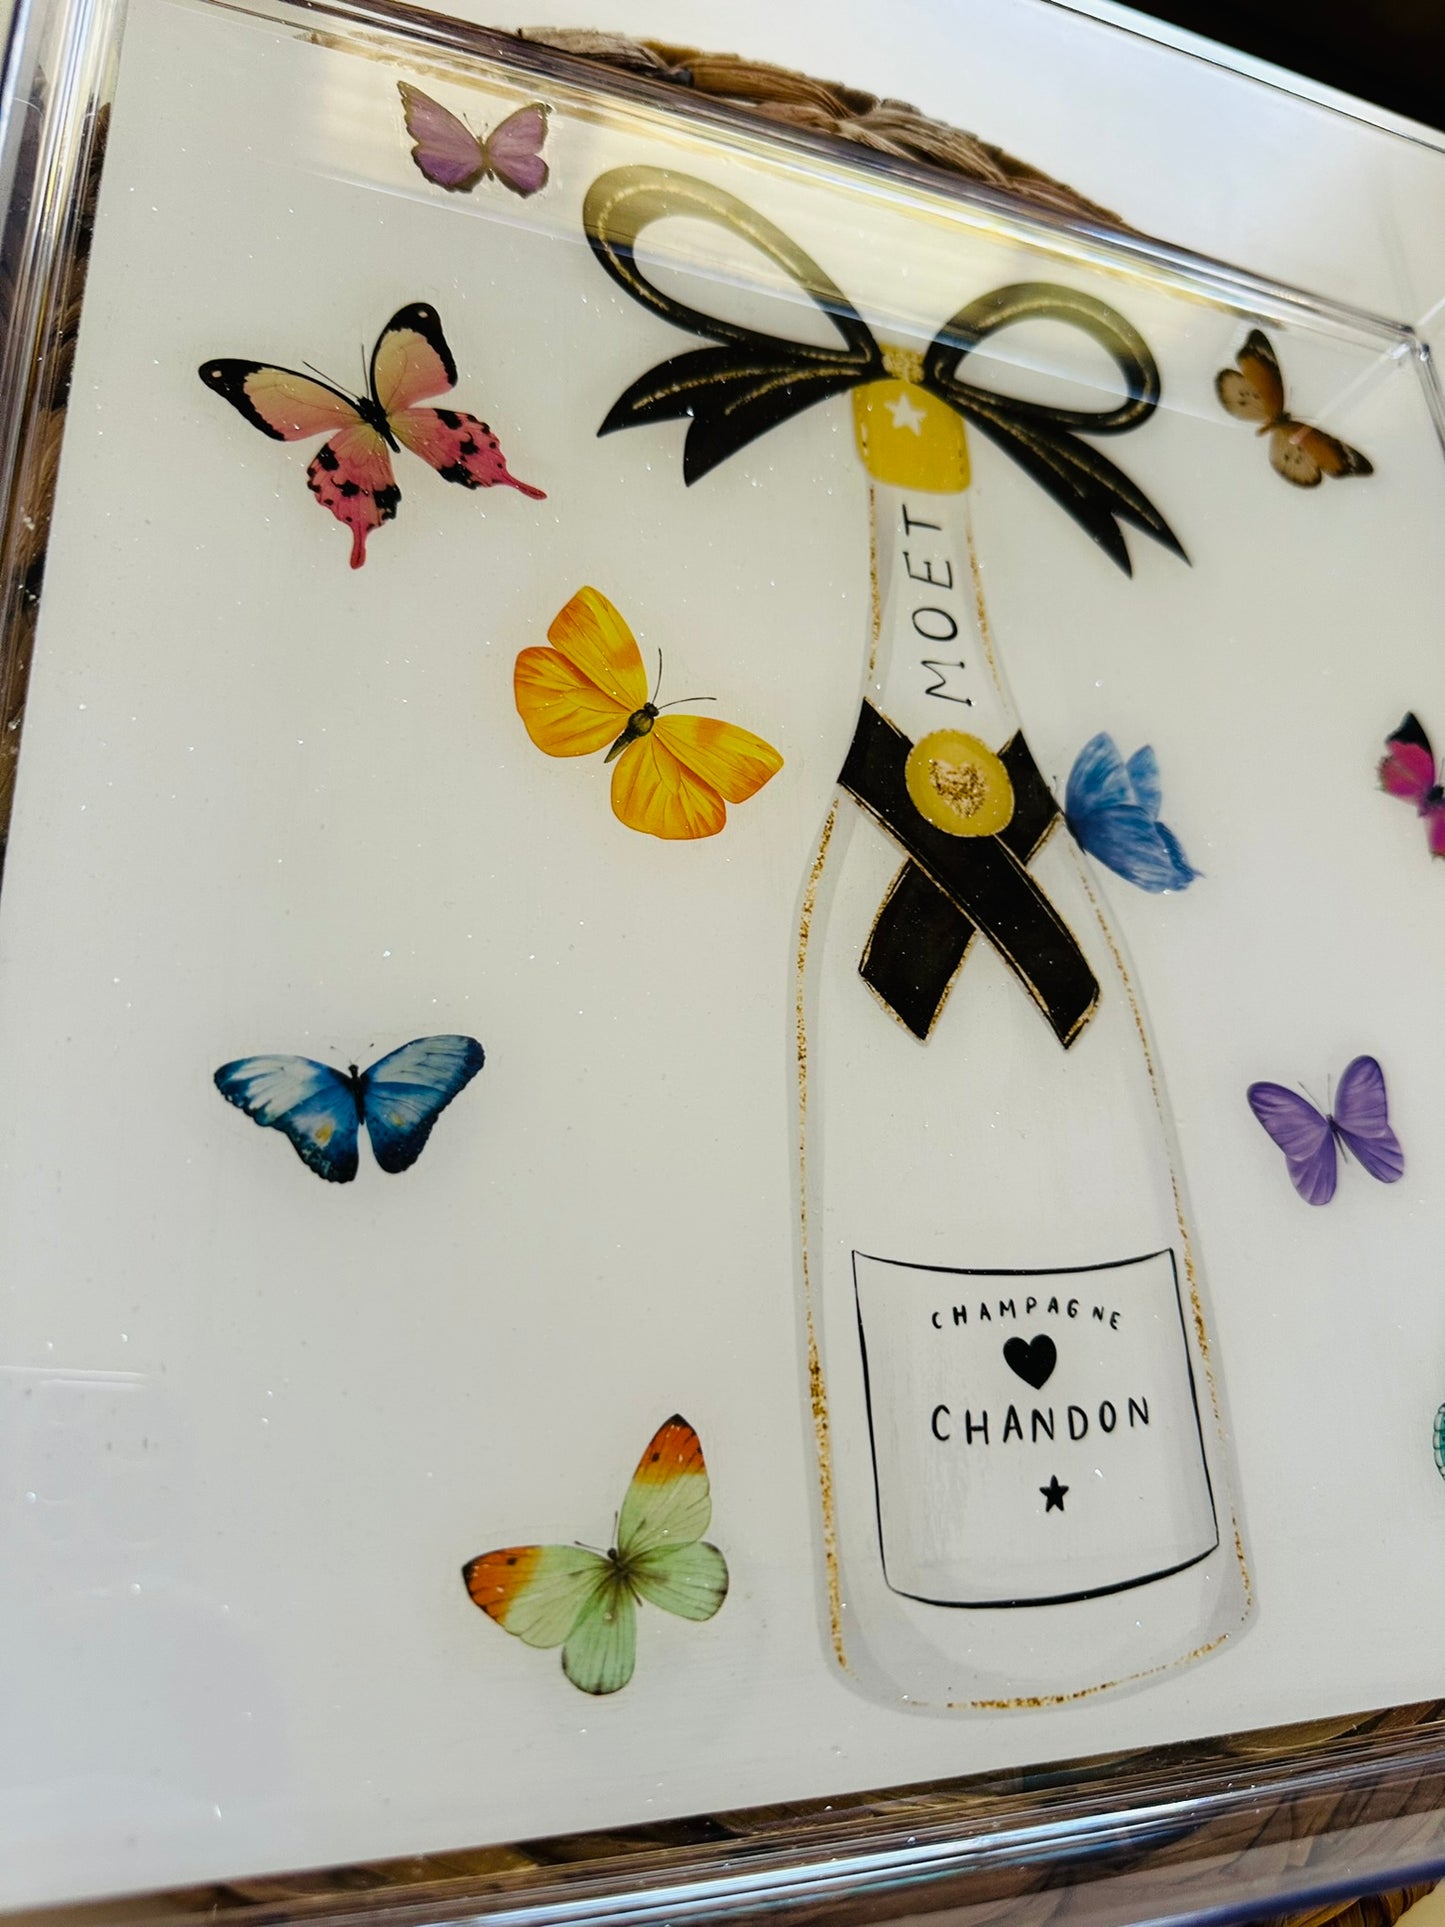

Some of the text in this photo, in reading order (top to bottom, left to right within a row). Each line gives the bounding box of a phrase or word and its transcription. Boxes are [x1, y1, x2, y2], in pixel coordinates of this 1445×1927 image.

[901, 503, 973, 708] MOET
[930, 1295, 1123, 1331] CHAMPAGNE
[930, 1395, 1151, 1447] CHANDON
